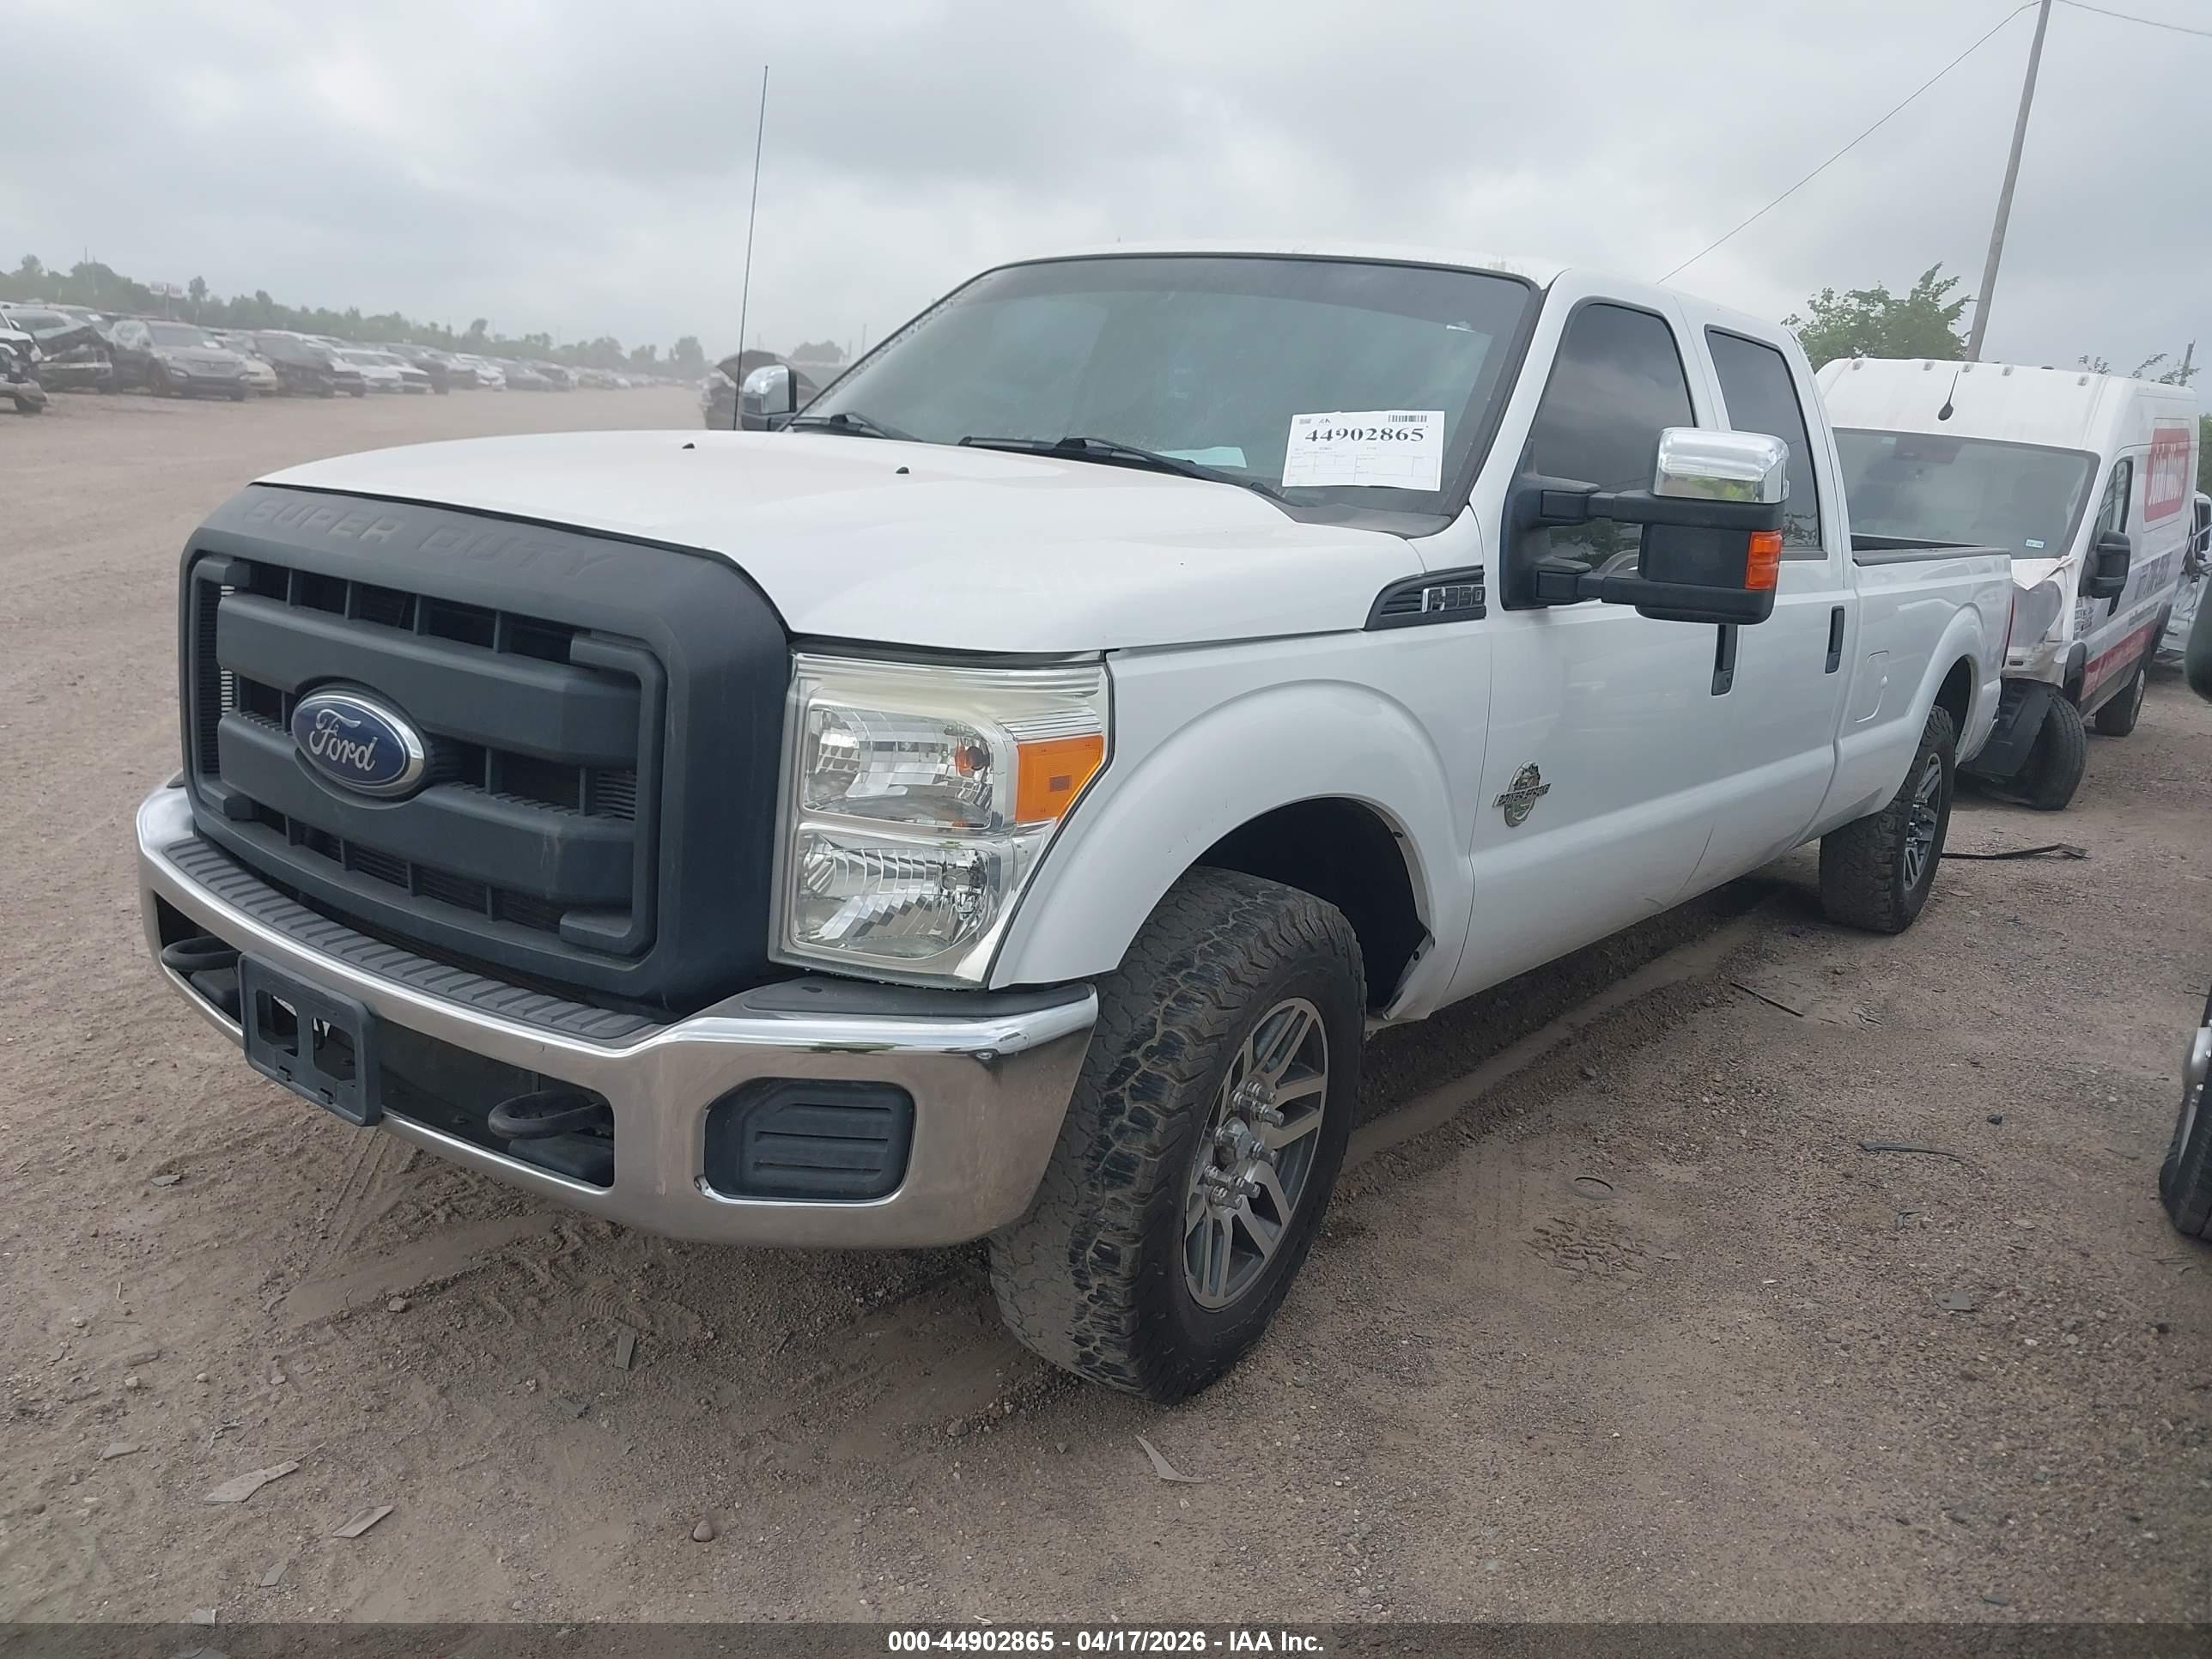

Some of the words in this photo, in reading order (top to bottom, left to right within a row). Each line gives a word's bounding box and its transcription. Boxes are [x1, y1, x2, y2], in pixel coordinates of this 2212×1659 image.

[1304, 427, 1425, 442] 44902865
[243, 500, 406, 545] SUPER
[417, 526, 619, 579] DUTY
[309, 708, 379, 771] Ford
